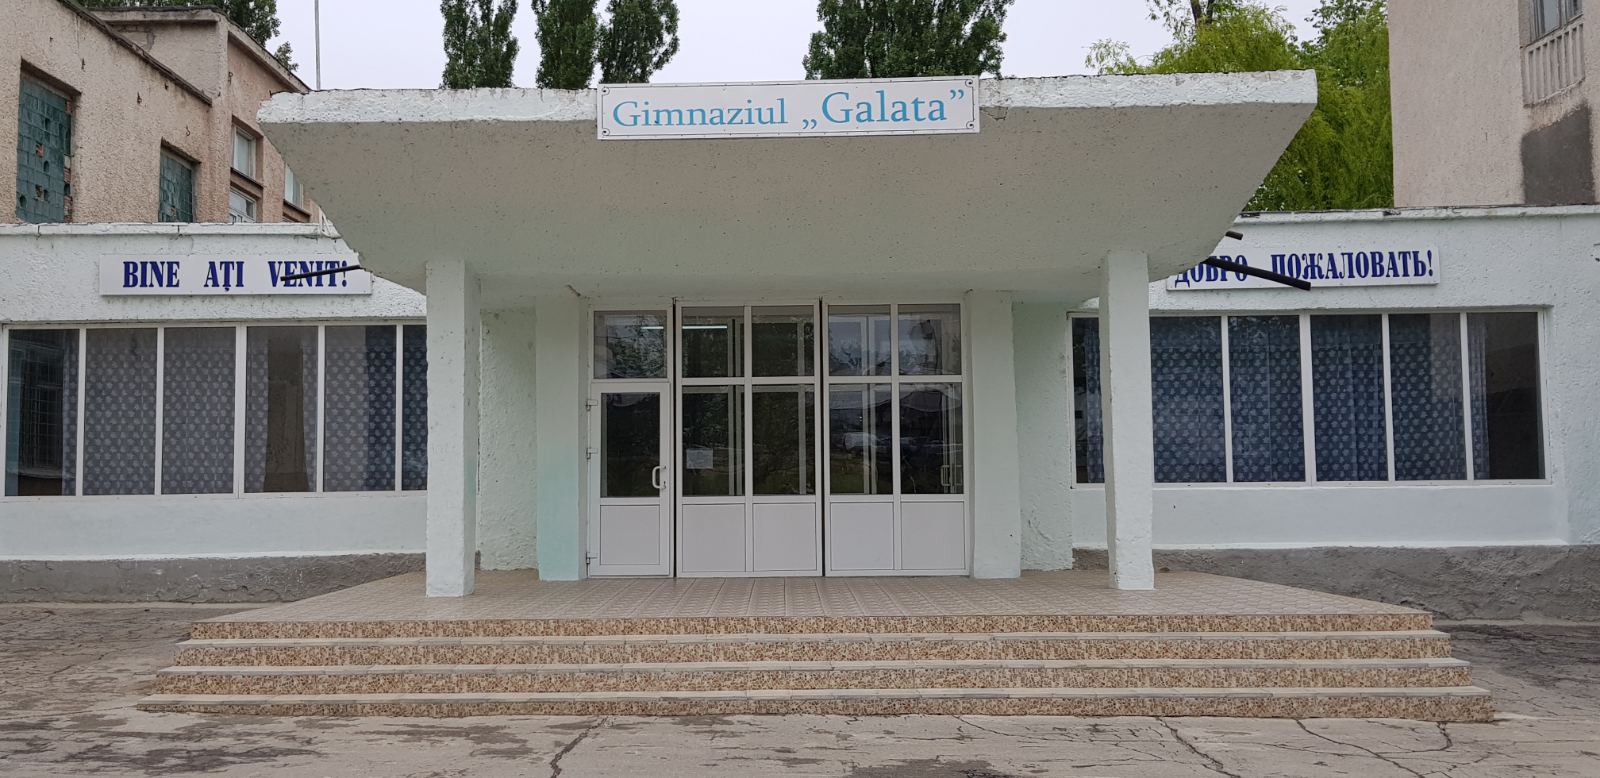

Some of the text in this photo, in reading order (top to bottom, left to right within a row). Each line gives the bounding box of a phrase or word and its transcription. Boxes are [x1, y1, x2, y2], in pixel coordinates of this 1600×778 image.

[612, 97, 788, 128] Gimnaziul
[122, 260, 180, 288] BINE
[268, 260, 348, 288] VENIT!
[1270, 249, 1434, 281] ПОЖАЛОВАТЬ!
